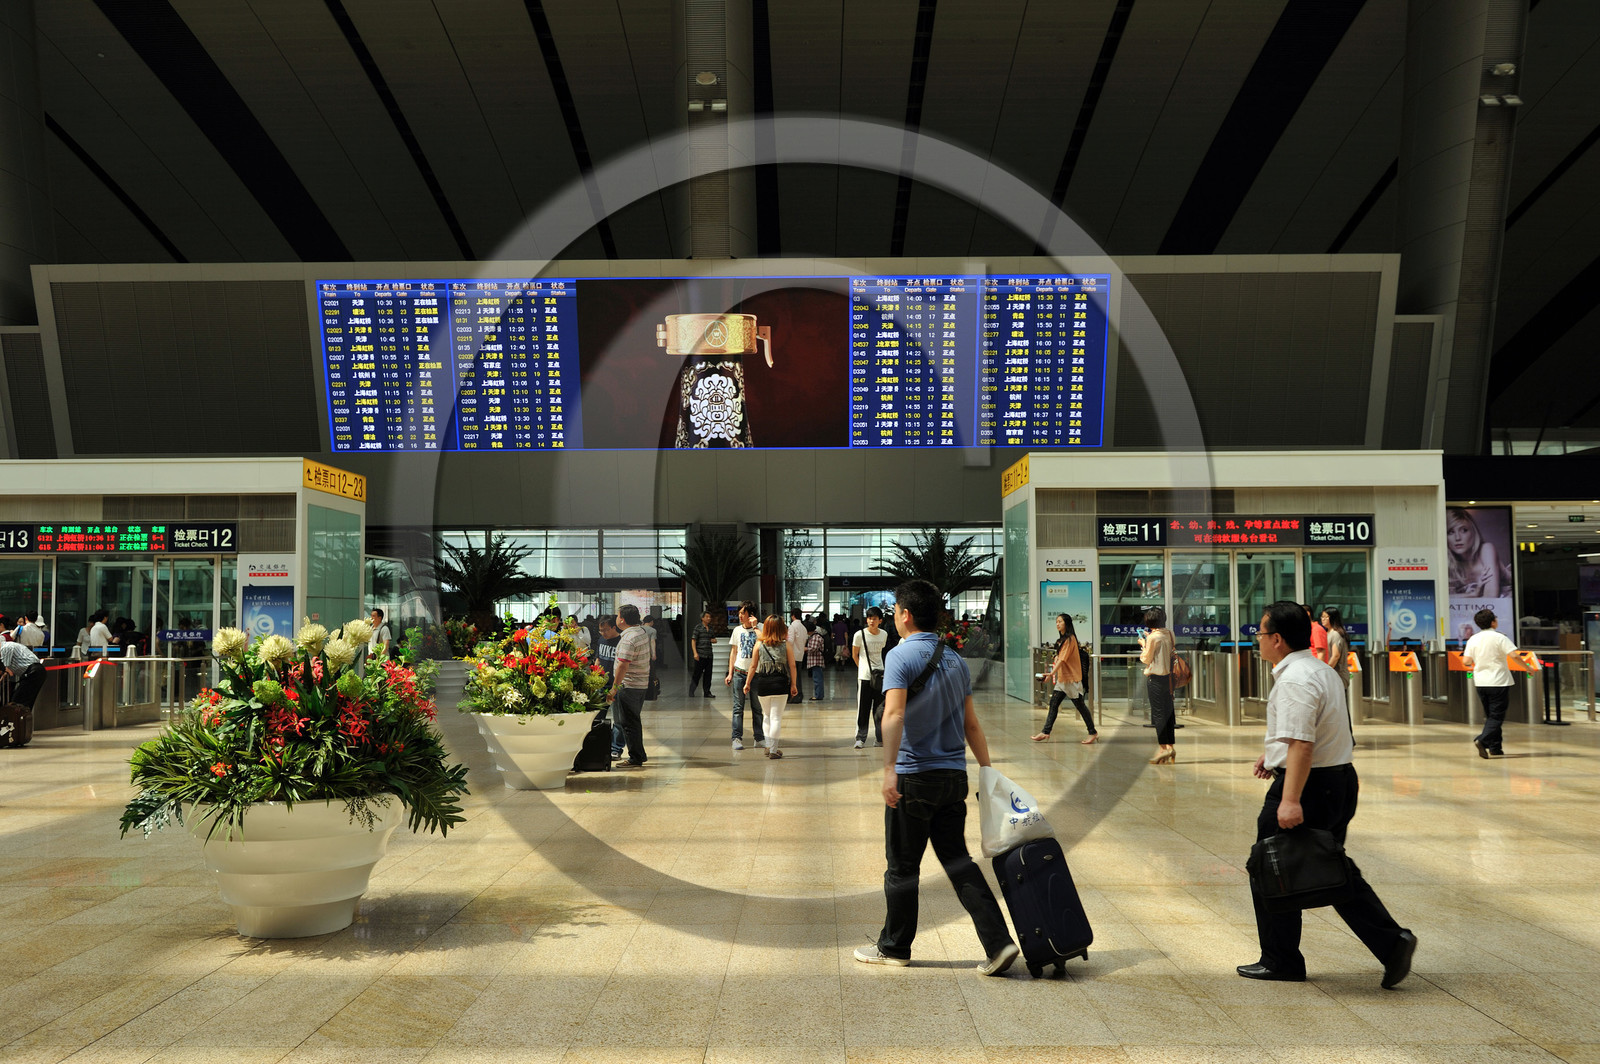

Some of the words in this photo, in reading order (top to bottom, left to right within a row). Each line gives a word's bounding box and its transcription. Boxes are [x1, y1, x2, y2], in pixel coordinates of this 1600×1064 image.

[314, 466, 336, 489] 检票口
[338, 473, 363, 498] 12-23
[8, 530, 28, 548] 13
[174, 529, 209, 541] 检票口
[211, 529, 232, 546] 12
[1103, 524, 1139, 535] 检票口
[1142, 523, 1160, 540] 11
[1310, 522, 1345, 534] 检票口
[1347, 522, 1369, 540] 10
